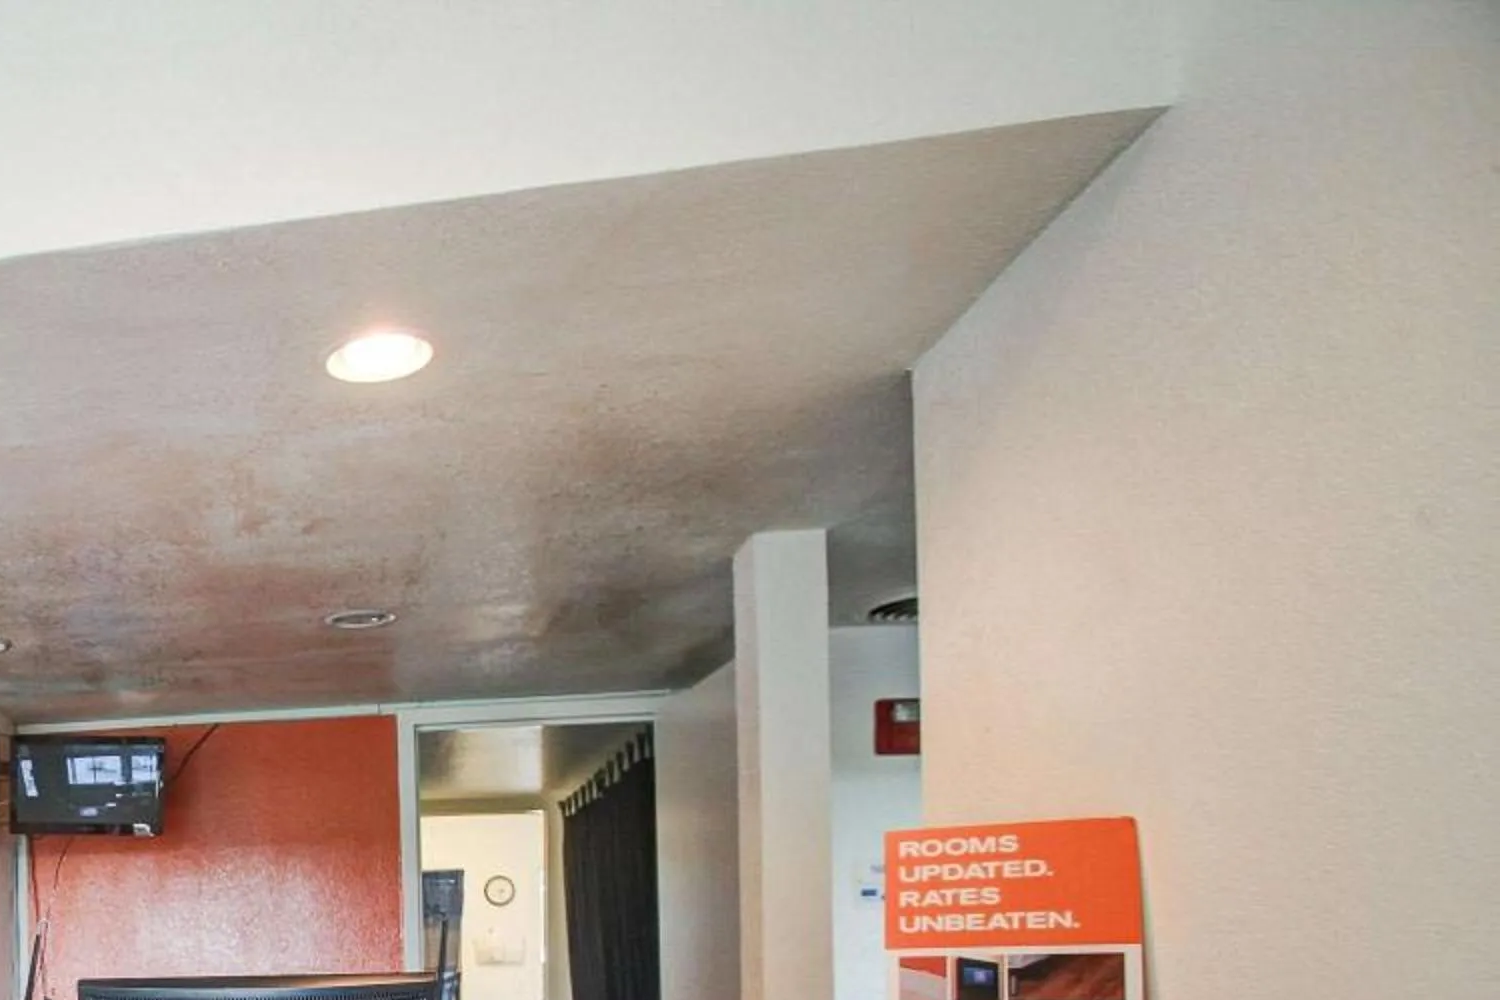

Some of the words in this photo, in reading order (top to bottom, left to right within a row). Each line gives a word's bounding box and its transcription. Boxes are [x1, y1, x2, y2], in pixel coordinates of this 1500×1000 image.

[899, 834, 1020, 858] ROOMS
[899, 859, 1055, 883] UPDATED.
[899, 886, 1002, 908] RATES
[899, 910, 1081, 934] UNBEATEN.
